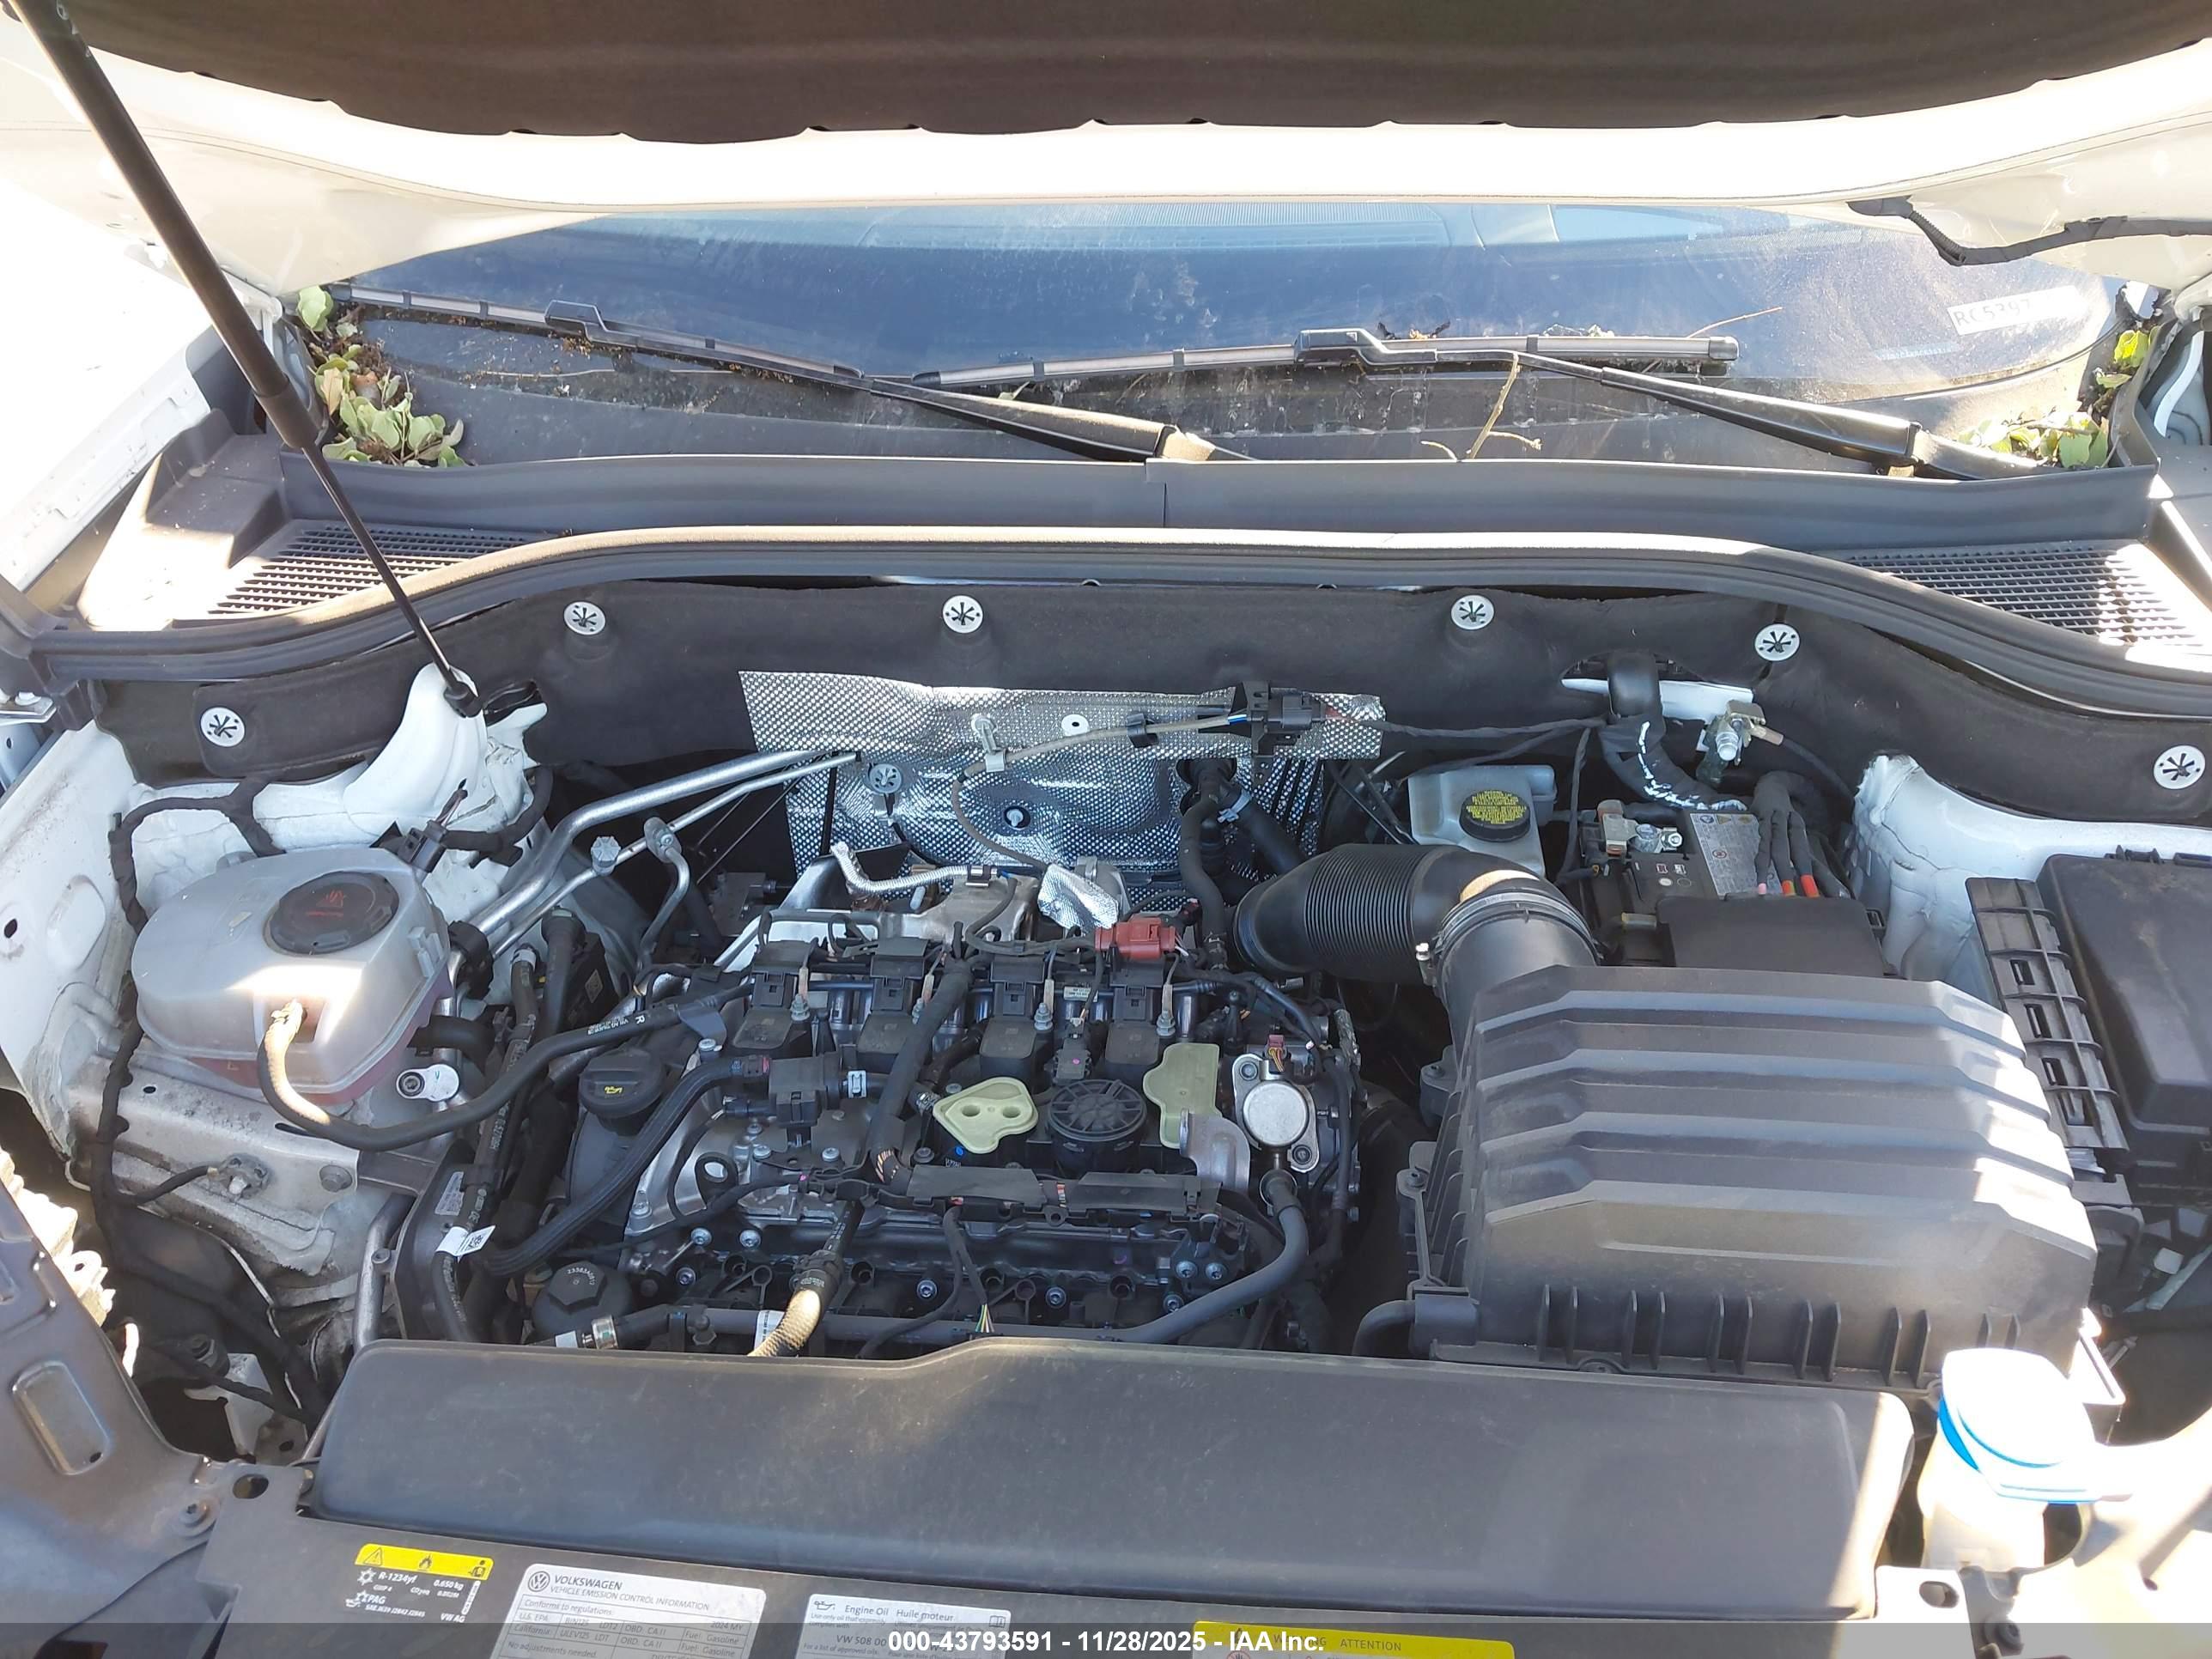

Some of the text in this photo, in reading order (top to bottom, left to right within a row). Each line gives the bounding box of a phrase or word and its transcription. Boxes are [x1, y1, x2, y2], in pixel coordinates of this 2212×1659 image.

[378, 1571, 418, 1585] R-1234yf
[555, 1575, 623, 1590] VOLKSWAGEN
[454, 1582, 465, 1592] kg
[525, 1599, 560, 1609] Conforms
[550, 1586, 709, 1610] VEHICLE EMISSION CONTROL INFORMATION
[845, 1605, 889, 1616] Engine Oil
[896, 1609, 955, 1622] Huile moteur
[515, 1624, 550, 1636] California
[707, 1634, 739, 1644] Gasoline
[836, 1635, 887, 1647] VW 508 00
[1340, 1638, 1401, 1651] ATTENTION
[702, 1646, 735, 1657] Gasoline
